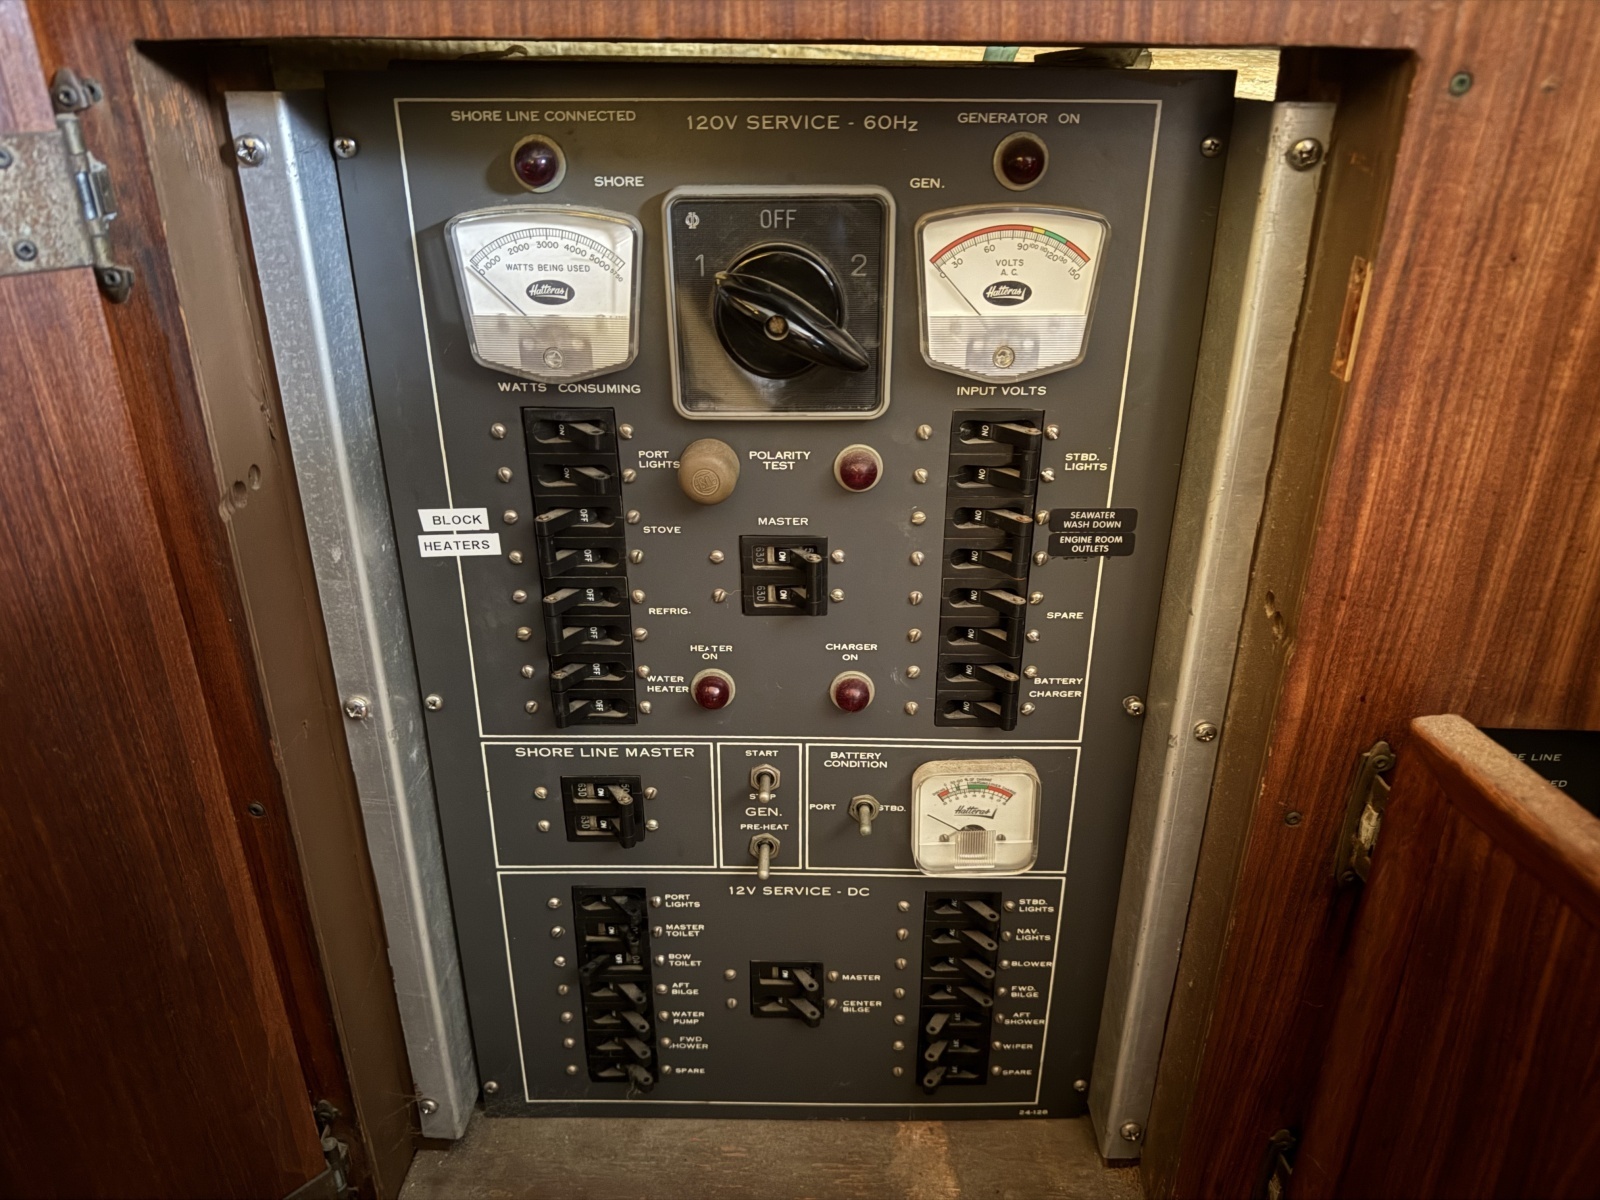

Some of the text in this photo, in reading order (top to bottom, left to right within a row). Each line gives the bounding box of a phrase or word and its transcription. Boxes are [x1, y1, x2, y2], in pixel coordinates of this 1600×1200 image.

[451, 110, 636, 122] SHORE LINE CONNECTED
[957, 113, 1080, 124] GENERATOR ON
[687, 115, 738, 130] 120V
[747, 115, 840, 130] SERVICE
[864, 115, 918, 131] 60Hz
[594, 176, 644, 187] SHORE
[910, 178, 945, 188] GEN.
[760, 209, 797, 228] OFF
[507, 242, 529, 255] 2000
[536, 241, 559, 249] 3000
[564, 242, 587, 257] 4000
[984, 244, 995, 253] 60
[1045, 250, 1059, 262] 120
[484, 255, 501, 271] 1000
[538, 264, 563, 272] BEING
[588, 254, 610, 271] 5000
[694, 254, 705, 276] 1
[850, 254, 867, 276] 2
[951, 258, 964, 268] 30
[478, 268, 486, 276] 0
[609, 268, 623, 282] 5750
[939, 271, 946, 279] 0
[1068, 267, 1081, 280] 150
[529, 284, 568, 300] Hatteras
[986, 285, 1026, 300] Hatteras
[498, 382, 641, 394] WATTS CONSUMING
[956, 386, 1047, 396] INPUT VOLTS
[559, 424, 565, 435] ON
[982, 425, 989, 436] ON
[749, 451, 810, 460] POLARITY
[1065, 453, 1100, 461] STBD.
[763, 462, 795, 470] TEST
[1065, 463, 1107, 471] LIGHTS
[564, 468, 570, 479] ON
[978, 469, 986, 480] ON
[432, 515, 482, 525] BLOCK
[580, 509, 588, 522] OFF
[974, 510, 982, 521] ON
[424, 540, 490, 551] HEATERS
[584, 549, 592, 562] OFF
[779, 552, 786, 561] ON
[971, 551, 978, 561] ON
[586, 588, 594, 601] OFF
[780, 590, 787, 599] ON
[971, 590, 977, 600] ON
[590, 627, 598, 639] OFF
[968, 629, 974, 639] ON
[966, 665, 972, 675] ON
[596, 700, 604, 711] OFF
[963, 702, 970, 711] ON
[515, 748, 695, 757] SHORE LINE MASTER
[824, 760, 887, 768] CONDITION
[745, 807, 782, 816] GEN.
[729, 886, 756, 895] 12V
[763, 887, 831, 895] SERVICE
[848, 888, 870, 896] DC
